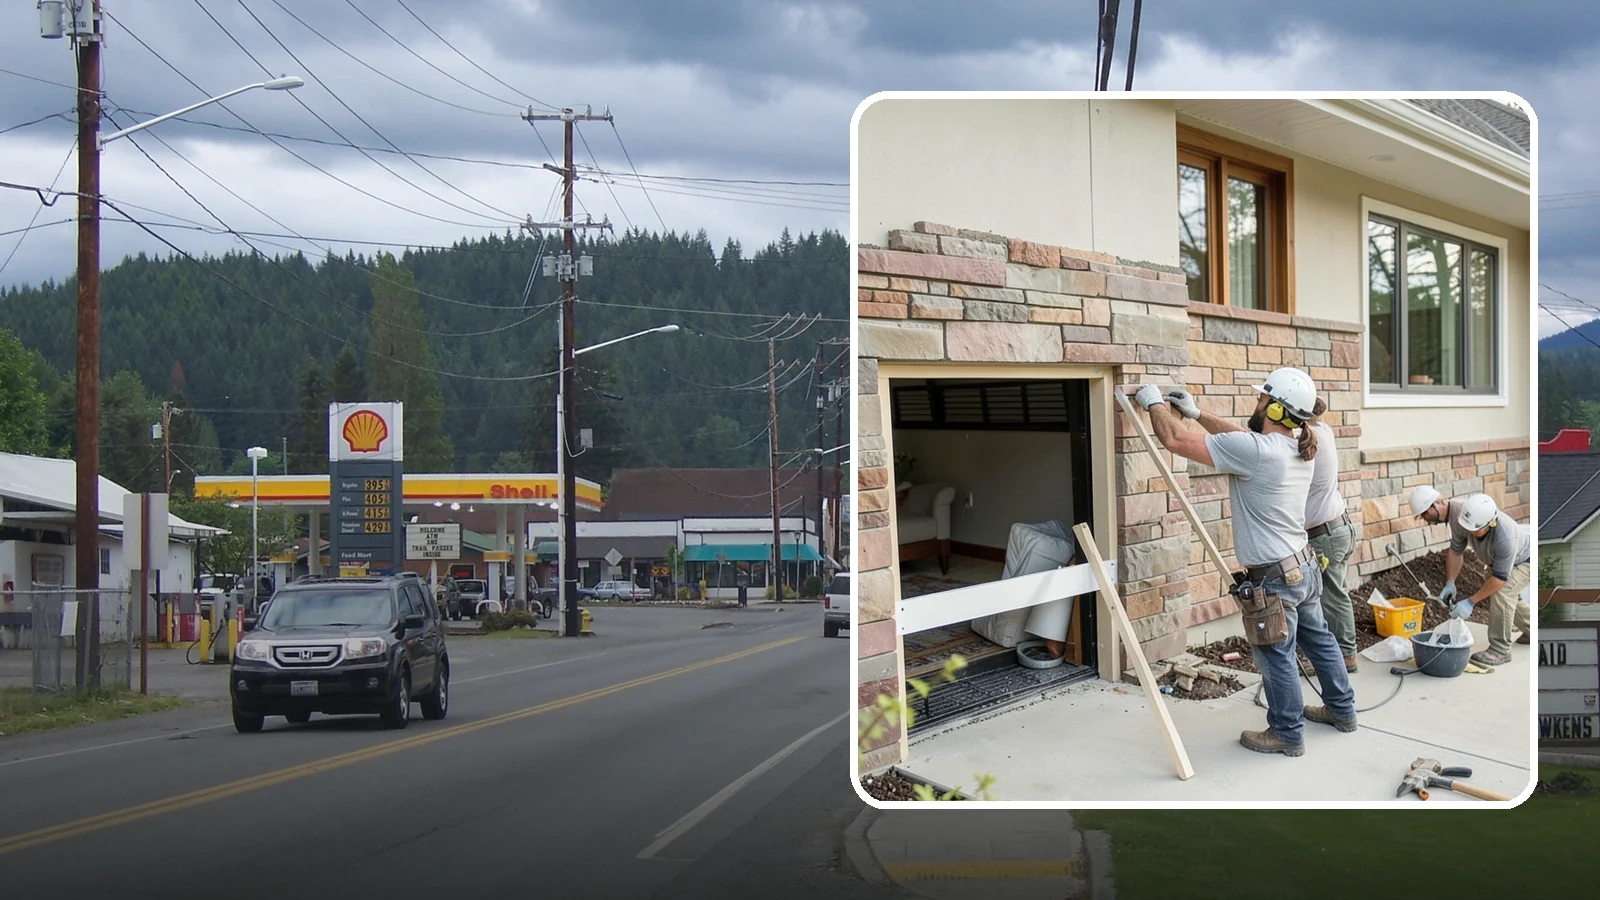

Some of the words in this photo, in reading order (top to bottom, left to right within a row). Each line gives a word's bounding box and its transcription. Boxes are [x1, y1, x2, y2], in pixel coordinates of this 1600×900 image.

[366, 480, 383, 490] 395
[490, 485, 547, 498] Shell
[366, 494, 383, 504] 405
[366, 508, 383, 518] 415
[366, 523, 383, 532] 429
[1539, 643, 1566, 665] AID
